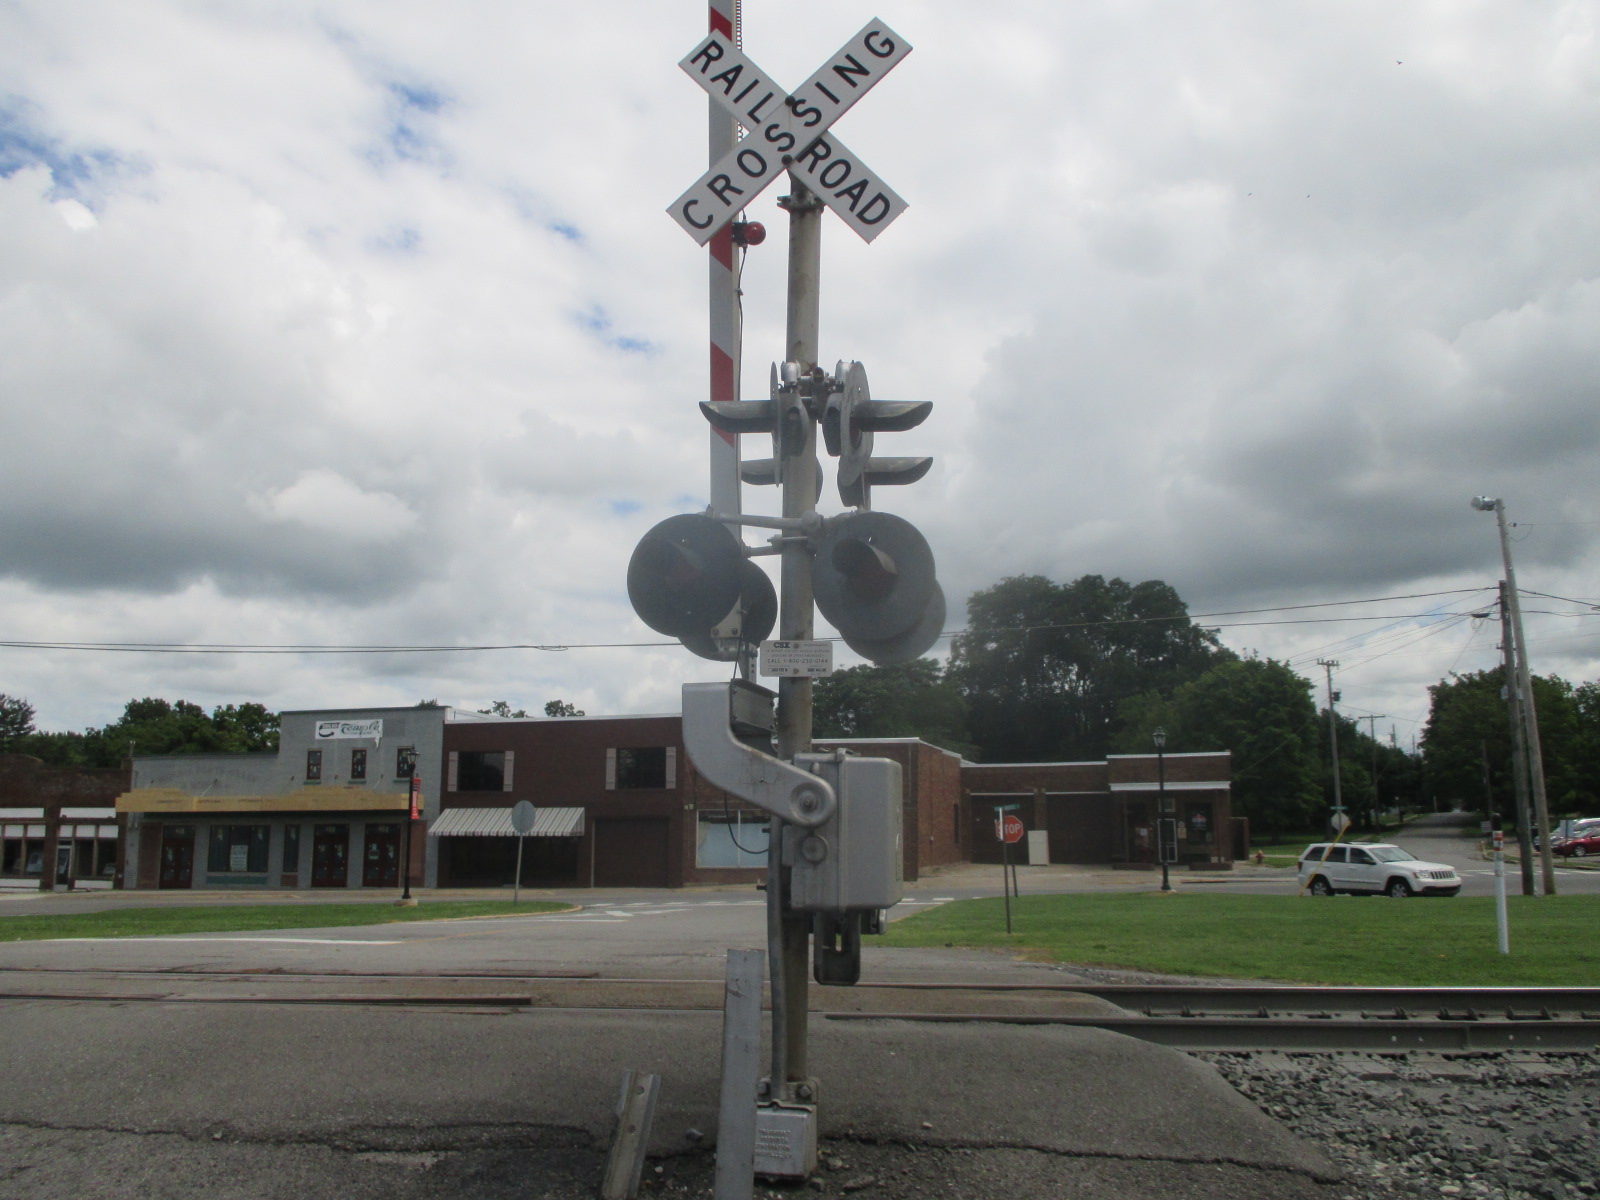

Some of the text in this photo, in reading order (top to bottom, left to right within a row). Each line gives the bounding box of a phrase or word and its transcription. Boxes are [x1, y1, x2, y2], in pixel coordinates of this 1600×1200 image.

[682, 30, 896, 230] CROSSING
[690, 39, 891, 225] RAIL ROAD
